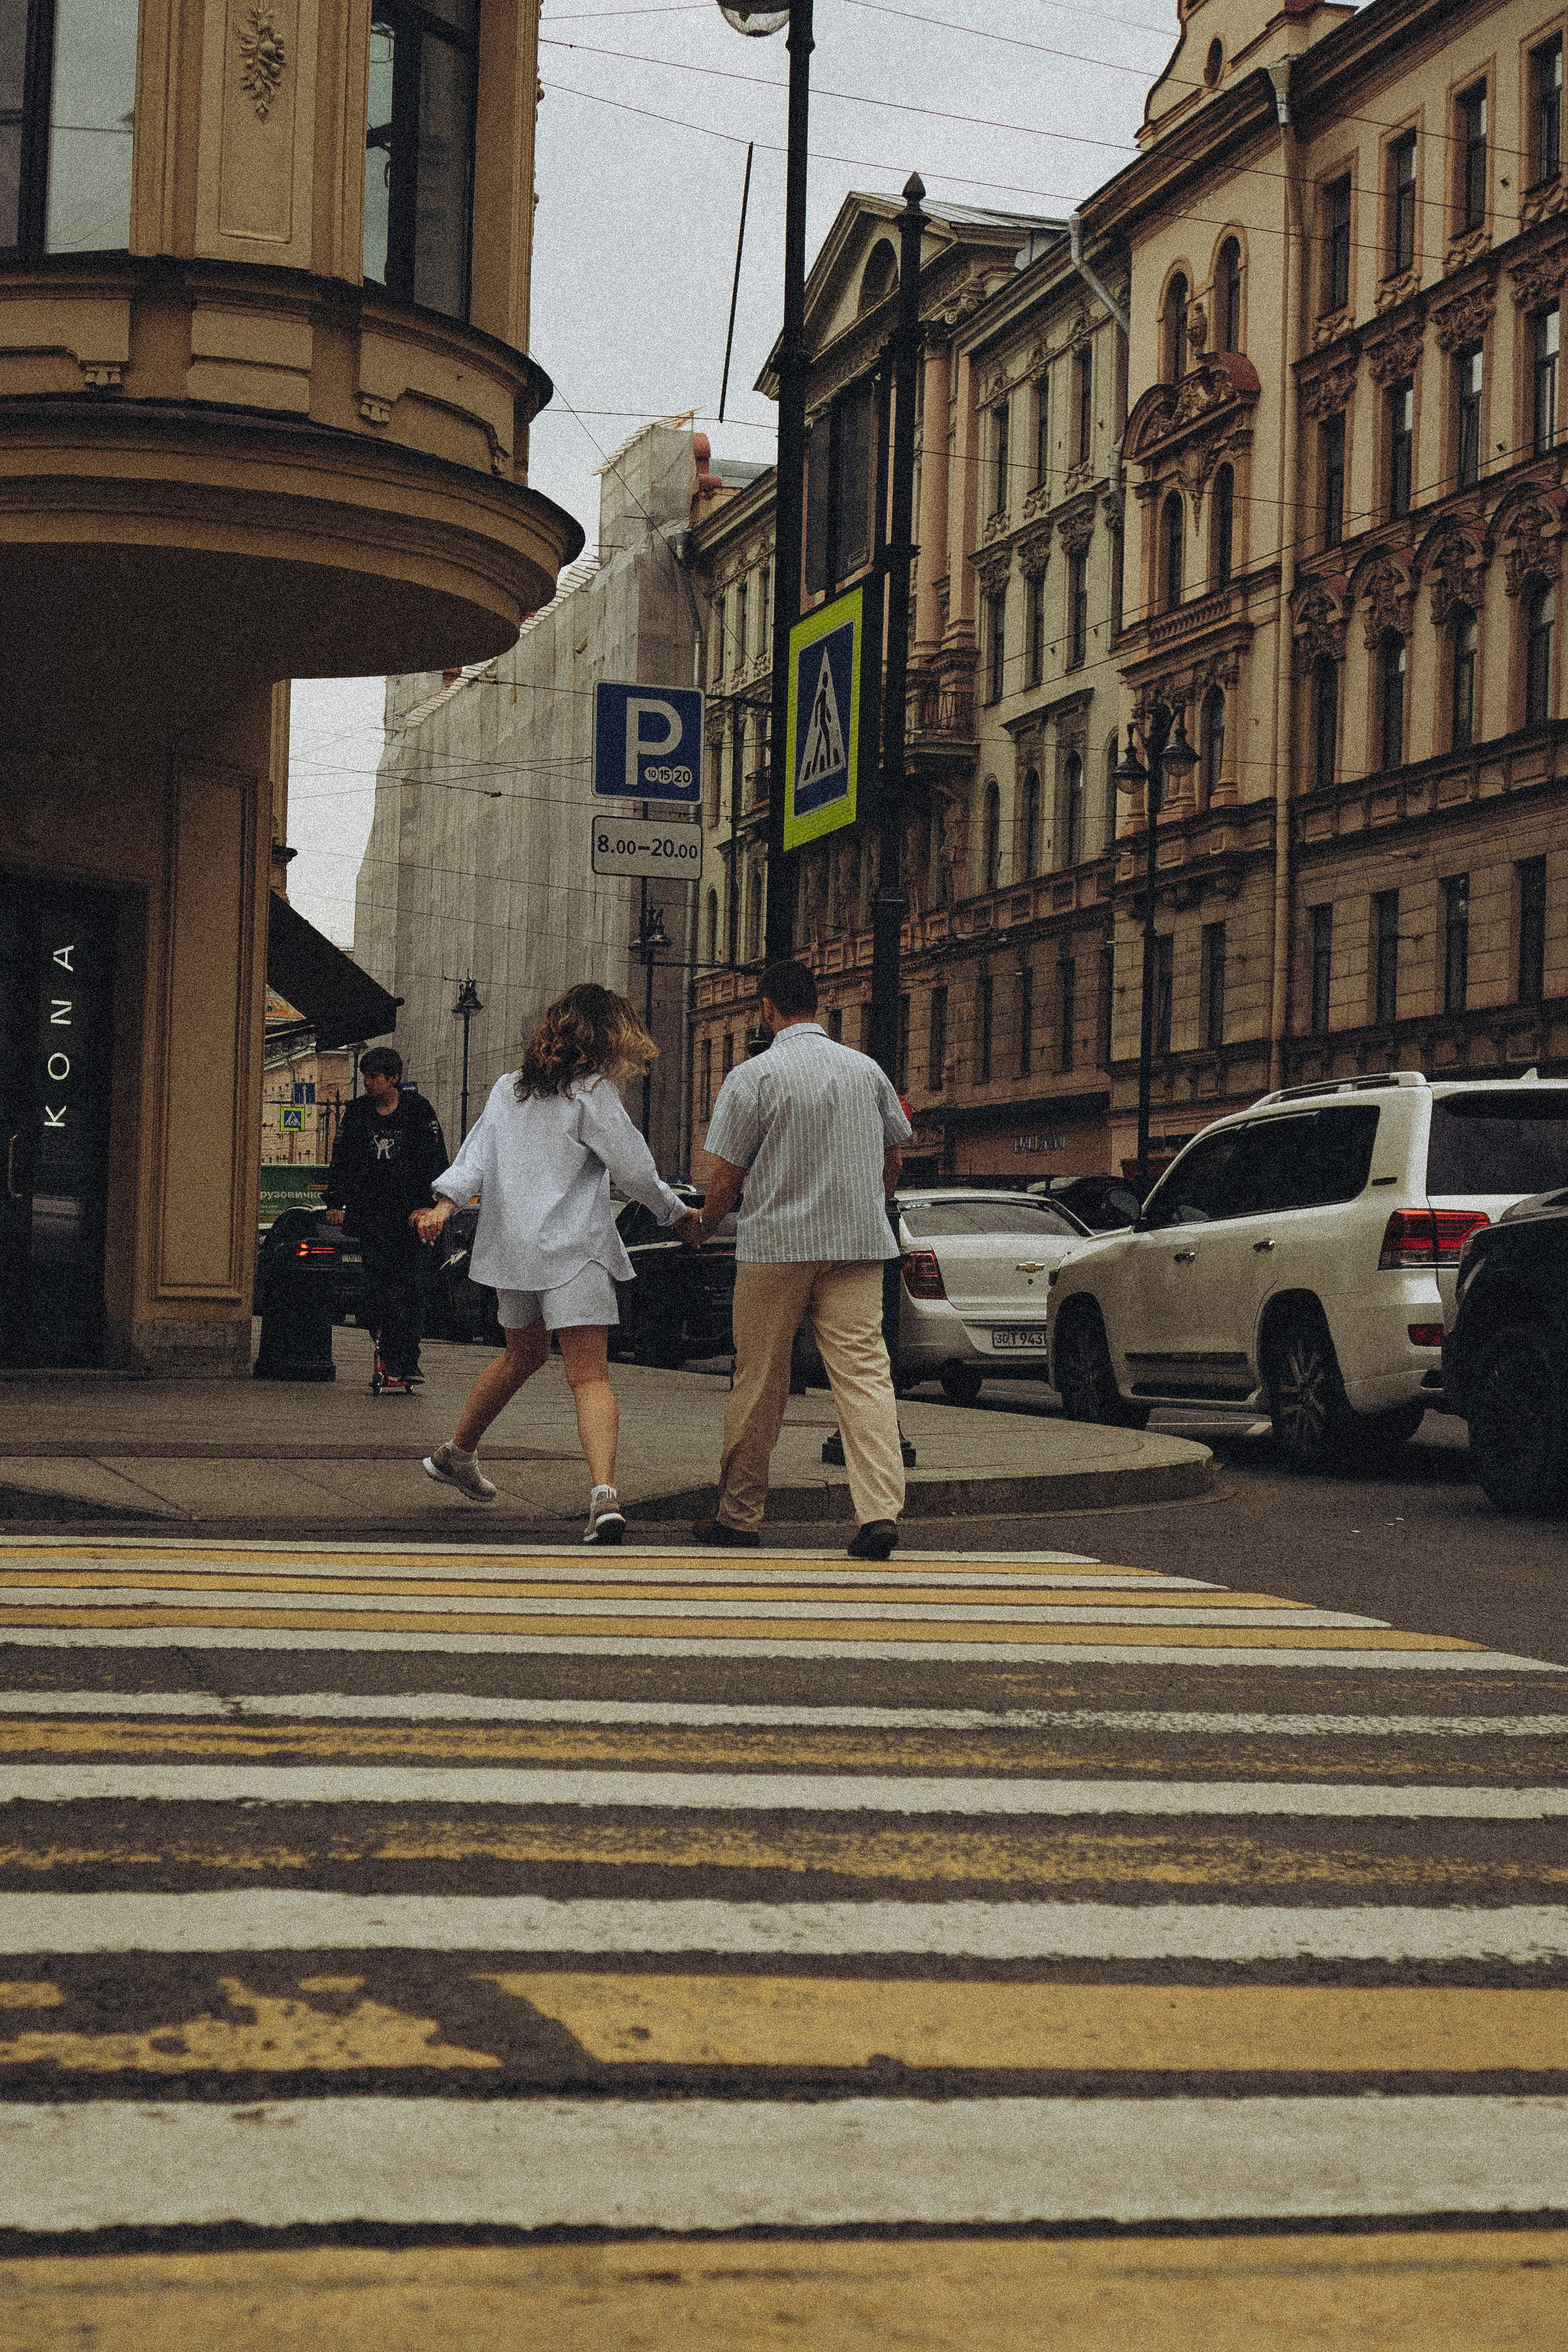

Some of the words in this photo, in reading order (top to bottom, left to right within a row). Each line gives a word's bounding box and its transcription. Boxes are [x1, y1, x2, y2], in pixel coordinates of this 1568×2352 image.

[625, 696, 683, 785] P
[647, 769, 657, 778] 10
[659, 769, 671, 781] 15
[674, 769, 691, 782] 20
[44, 944, 74, 1127] KONA
